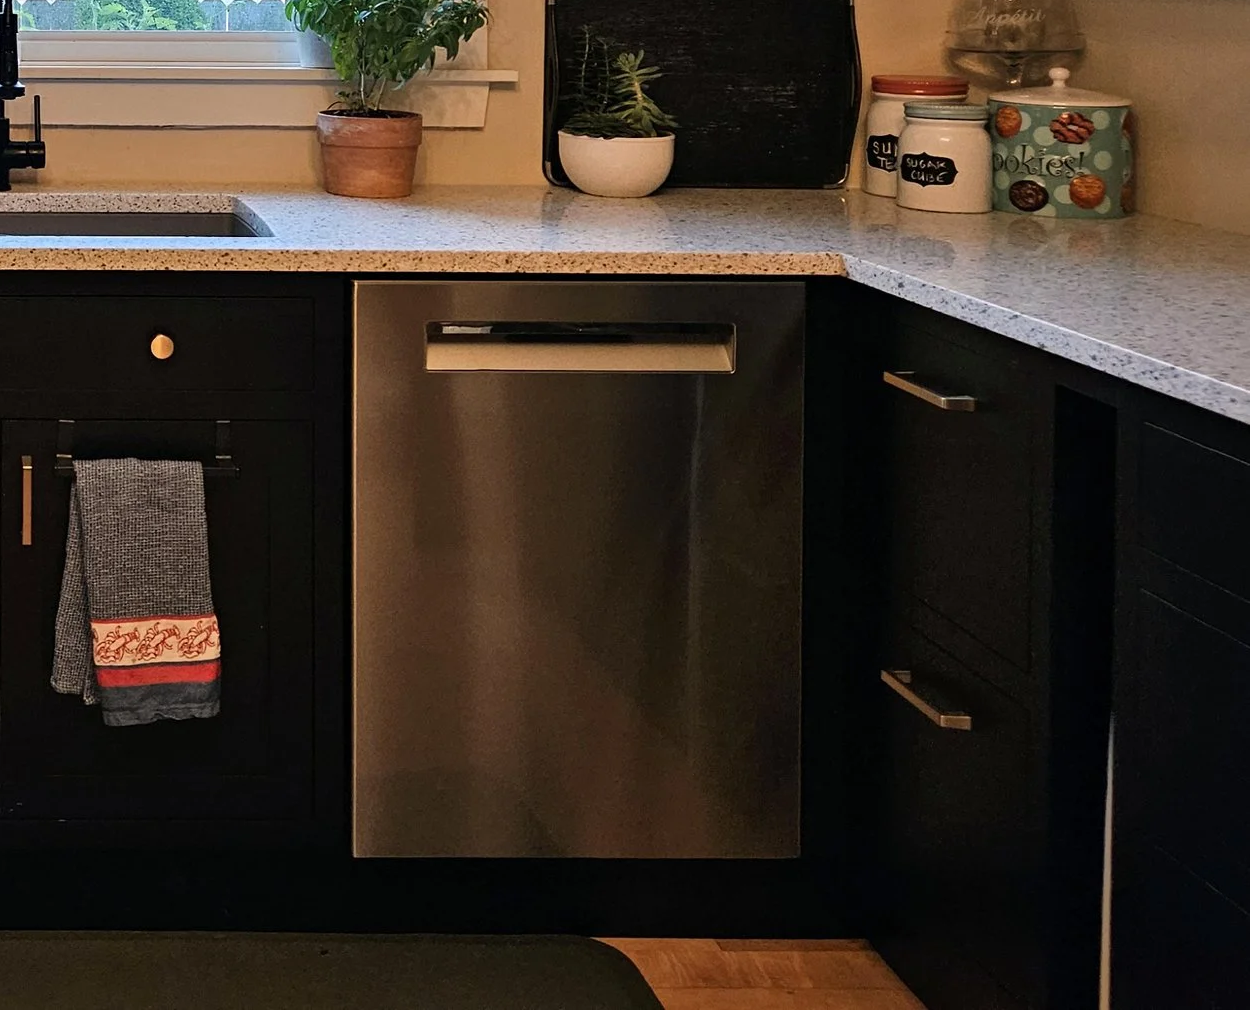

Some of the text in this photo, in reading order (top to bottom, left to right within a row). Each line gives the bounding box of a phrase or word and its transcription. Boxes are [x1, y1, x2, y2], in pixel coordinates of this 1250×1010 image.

[877, 156, 898, 170] TE
[906, 157, 947, 170] SUGAR
[993, 144, 1085, 179] ookies!
[910, 170, 949, 183] CUBE
